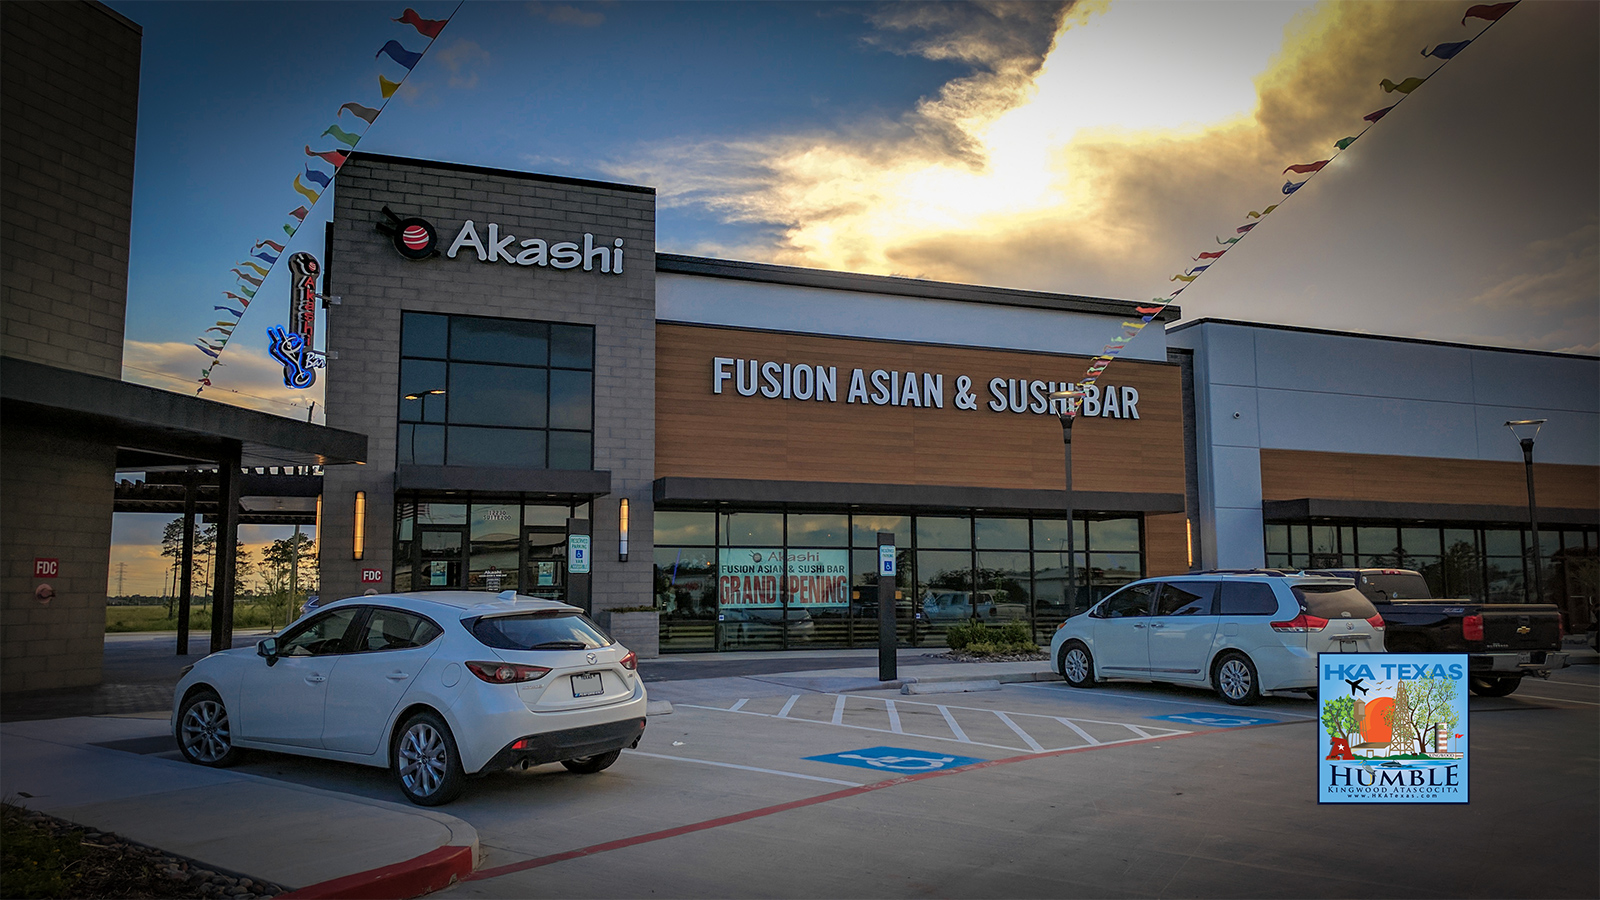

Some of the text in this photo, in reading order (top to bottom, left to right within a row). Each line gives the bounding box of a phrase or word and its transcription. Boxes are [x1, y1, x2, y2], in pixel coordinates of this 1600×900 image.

[446, 219, 624, 275] Akashi
[305, 352, 326, 368] Bar
[713, 356, 1140, 420] FUSION ASIAN & SUSHI BAR
[767, 551, 820, 562] Akashi
[36, 560, 57, 575] FDC
[721, 564, 755, 574] FUSION
[757, 564, 785, 574] ASIAN
[788, 565, 795, 574] &
[827, 564, 845, 574] BAR
[363, 570, 381, 581] FDC
[719, 575, 848, 605] GRAND OPENING
